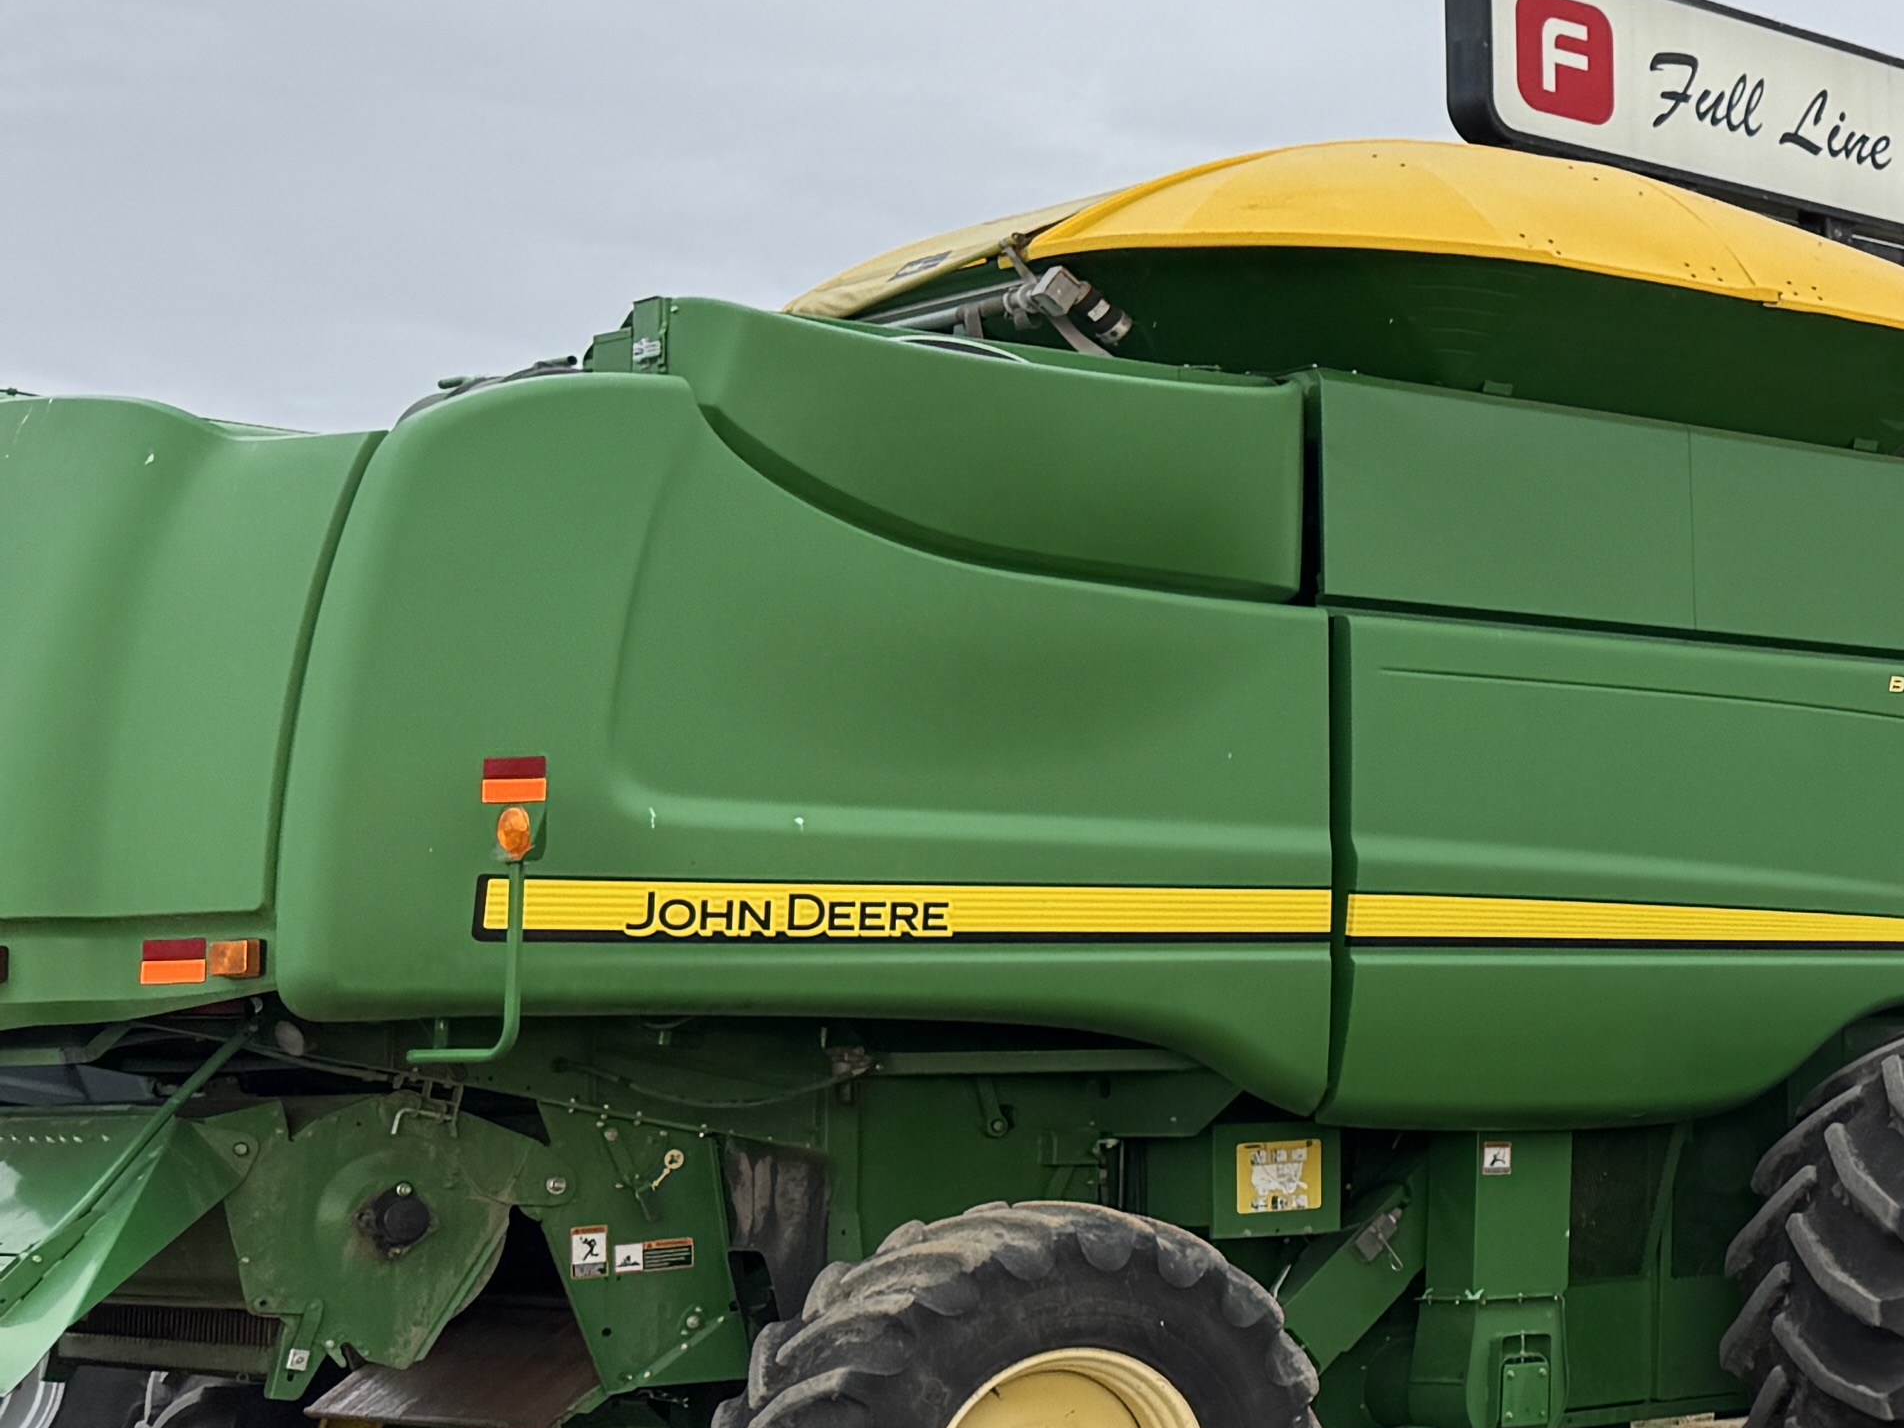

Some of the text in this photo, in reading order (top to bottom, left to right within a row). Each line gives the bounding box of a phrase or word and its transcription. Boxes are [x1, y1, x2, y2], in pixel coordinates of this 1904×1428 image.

[1541, 17, 1589, 93] F
[1648, 52, 1766, 137] Full
[1778, 90, 1893, 171] Line
[625, 891, 950, 932] JOHN DEERE
